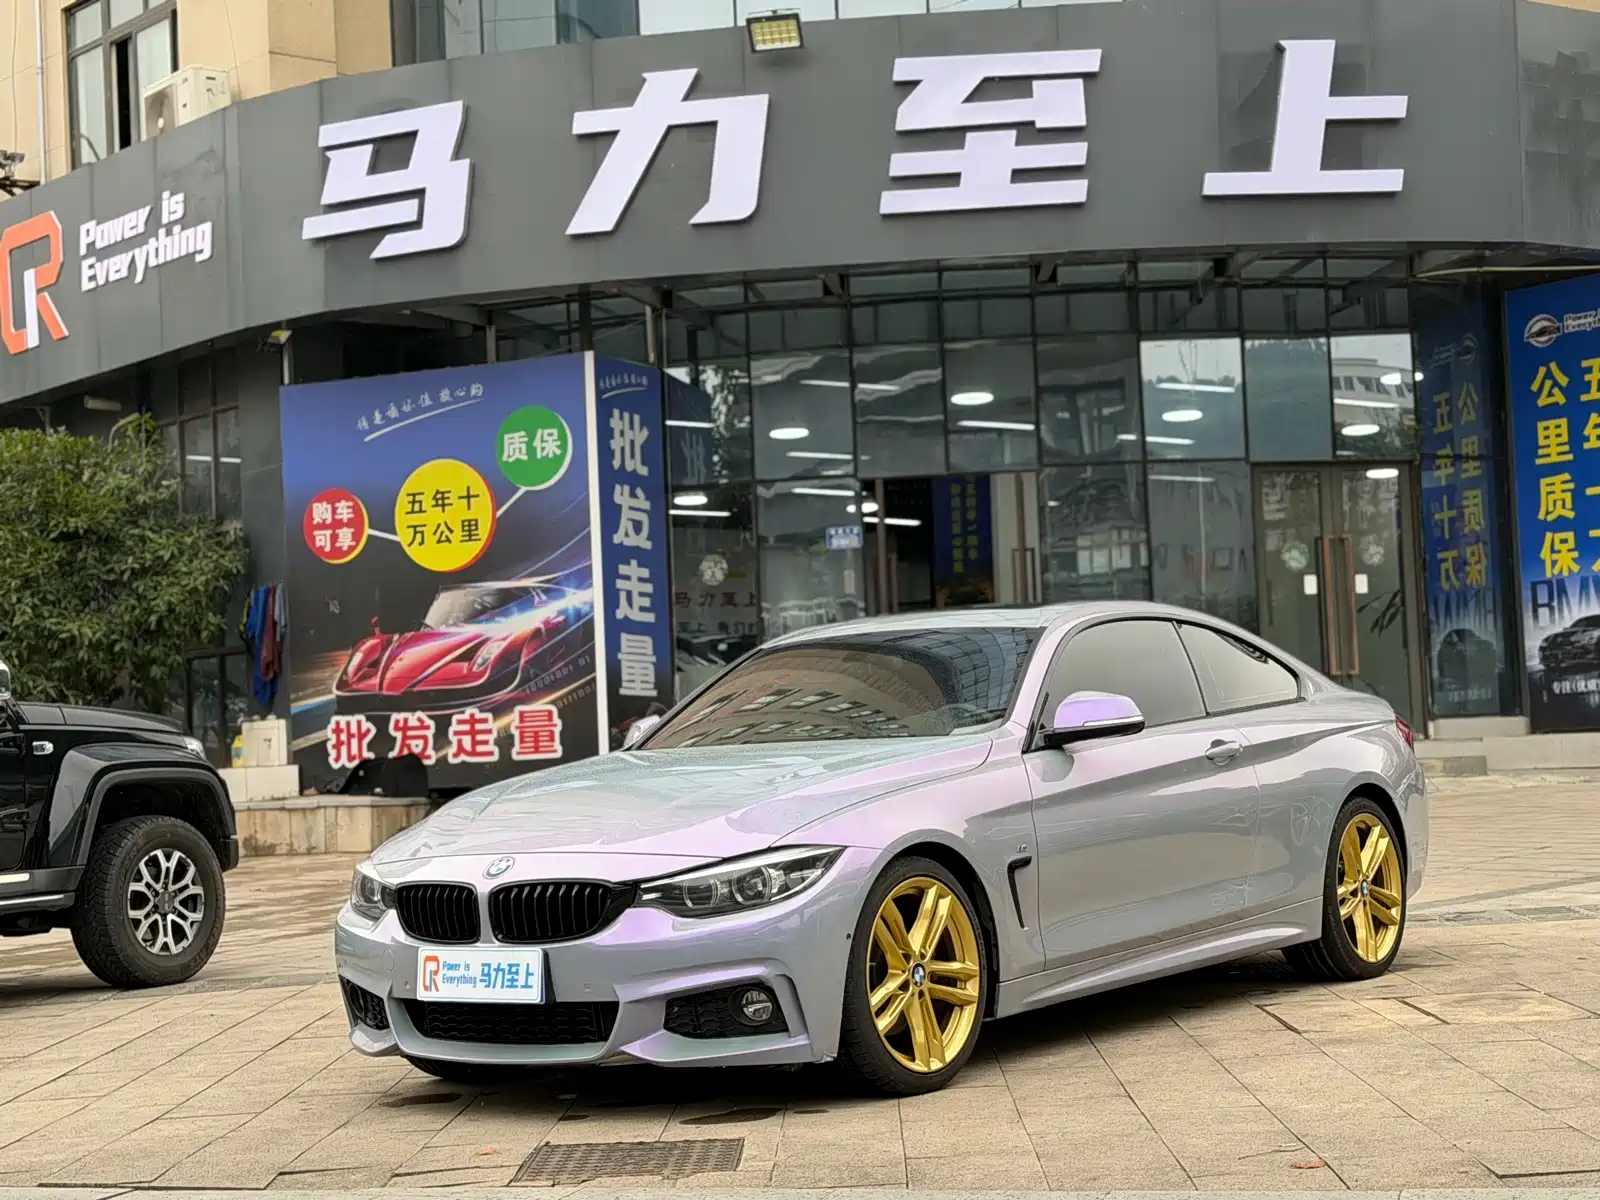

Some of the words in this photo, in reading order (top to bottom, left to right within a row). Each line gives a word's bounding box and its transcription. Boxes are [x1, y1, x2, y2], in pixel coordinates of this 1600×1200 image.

[301, 38, 1409, 260] 马力至上
[80, 205, 152, 256] Power
[161, 191, 185, 224] is
[80, 221, 213, 292] Everything
[501, 428, 562, 462] 质保
[1530, 361, 1581, 578] 公里质保
[311, 499, 355, 525] 购车
[405, 486, 481, 515] 五年十
[313, 528, 357, 552] 可享
[406, 519, 482, 547] 万公里
[609, 408, 659, 698] 批发走量
[328, 706, 562, 768] 批发走量
[442, 961, 461, 971] Power
[464, 961, 470, 971] is
[442, 974, 477, 988] Everything
[480, 962, 534, 989] 马力至上
